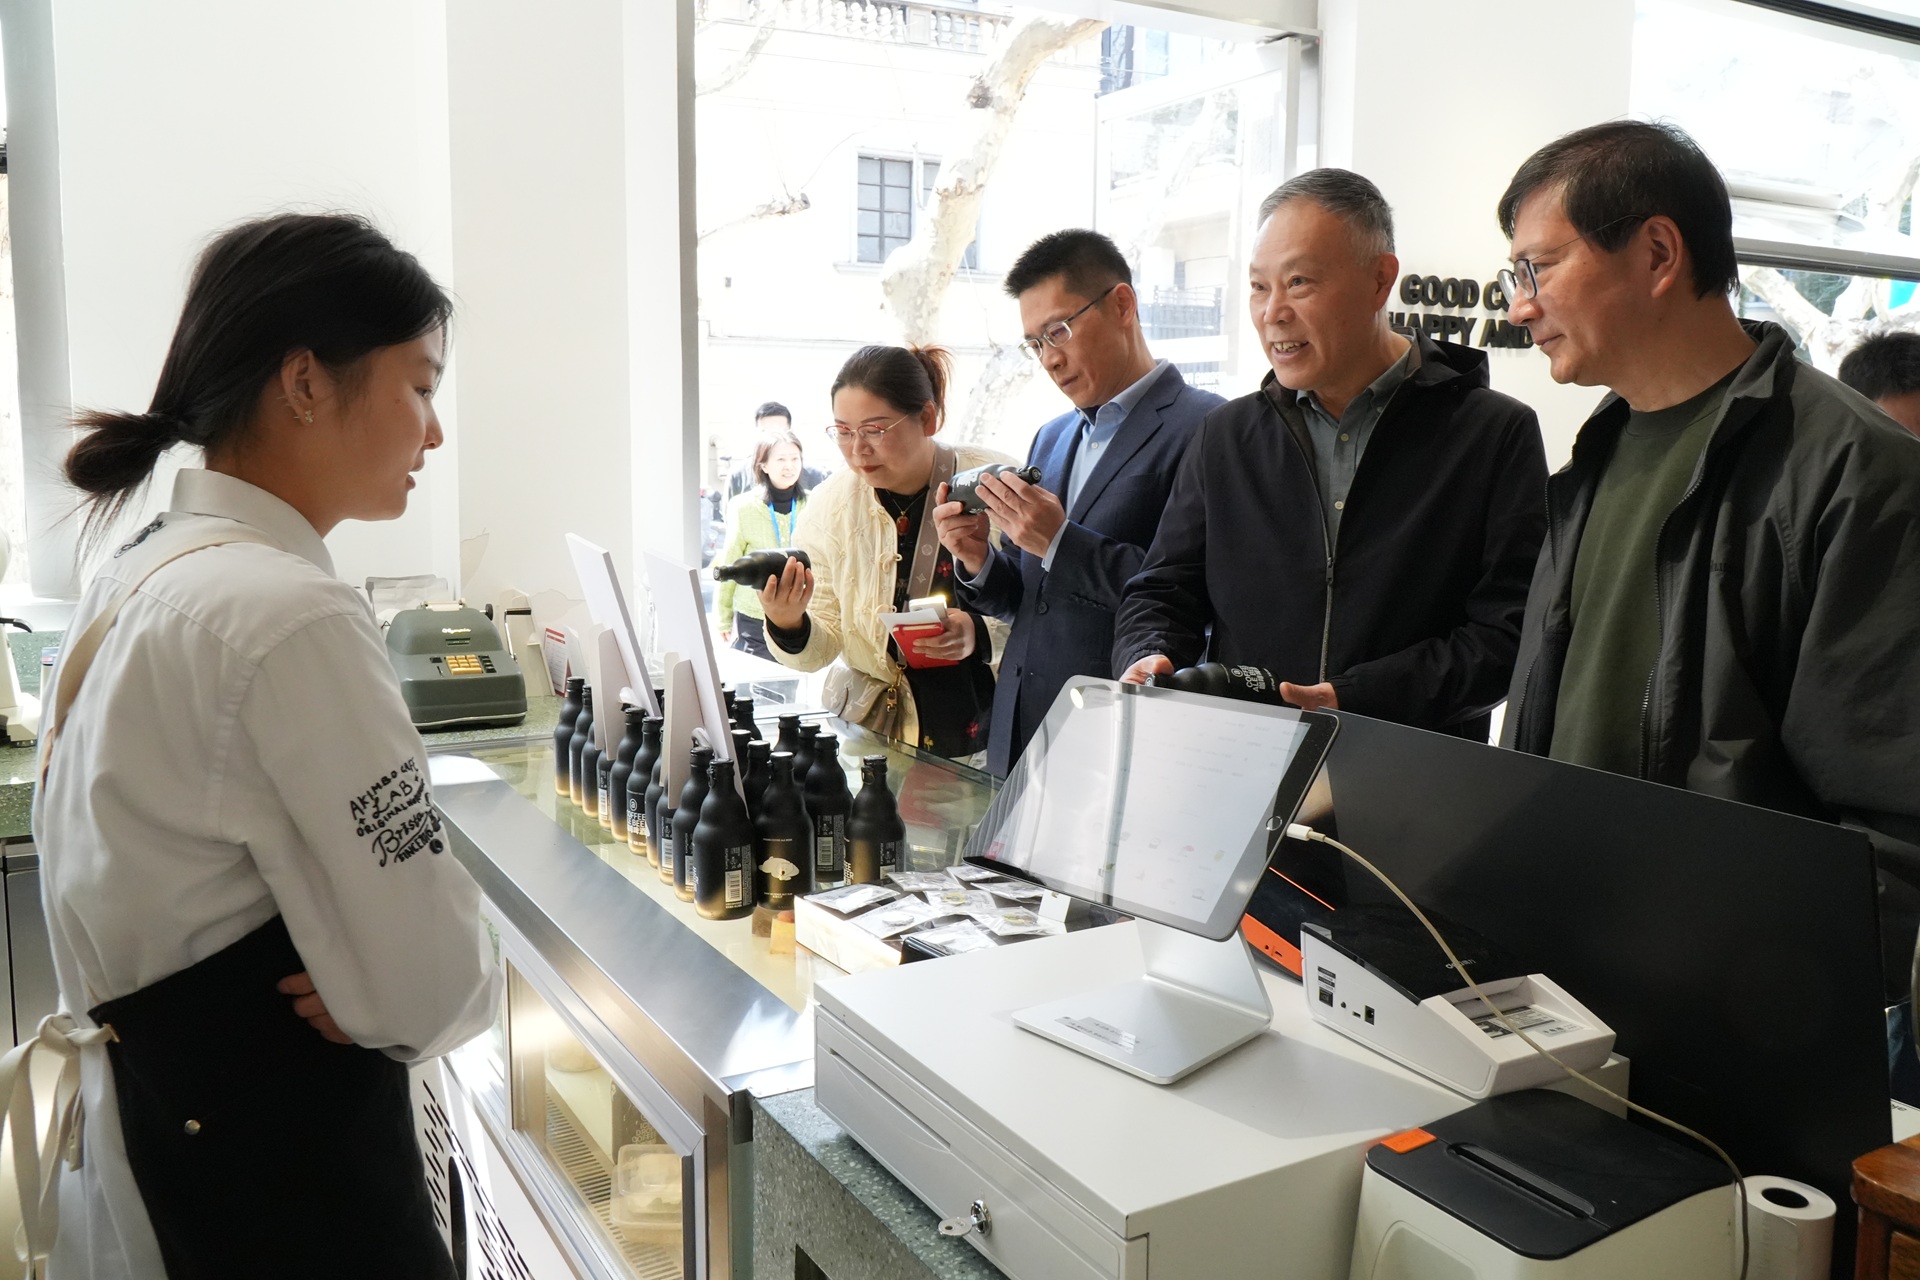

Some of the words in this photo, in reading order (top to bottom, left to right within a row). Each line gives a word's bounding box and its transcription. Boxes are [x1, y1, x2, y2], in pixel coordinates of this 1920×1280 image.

[1400, 273, 1480, 309] GOOD
[1482, 280, 1510, 313] C
[1478, 318, 1535, 349] AND
[349, 770, 398, 821] AKIMBO
[356, 802, 408, 837] ORIGINAL
